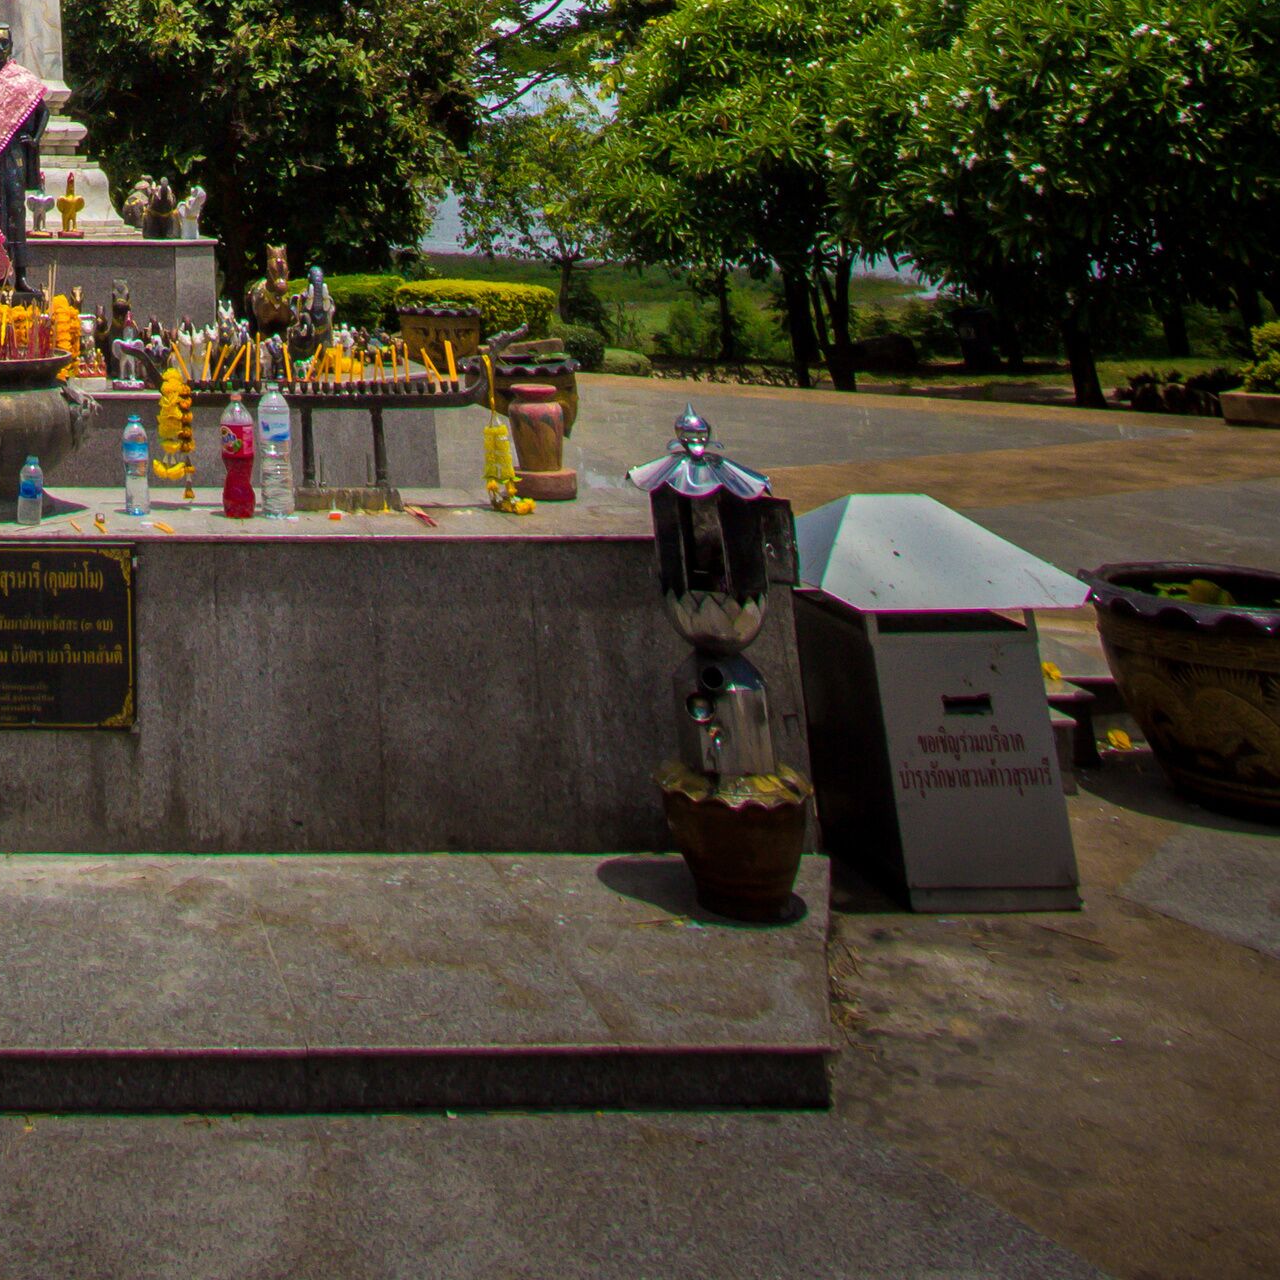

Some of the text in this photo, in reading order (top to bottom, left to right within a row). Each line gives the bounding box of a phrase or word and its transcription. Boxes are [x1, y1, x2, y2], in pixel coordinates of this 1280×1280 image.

[43, 560, 104, 597] (คุณย่าโม)
[917, 724, 1025, 761] ขอเชิญร่วมบริจาค
[898, 756, 1052, 799] บำรุงรักษาสวนท้าวสุรนารี
